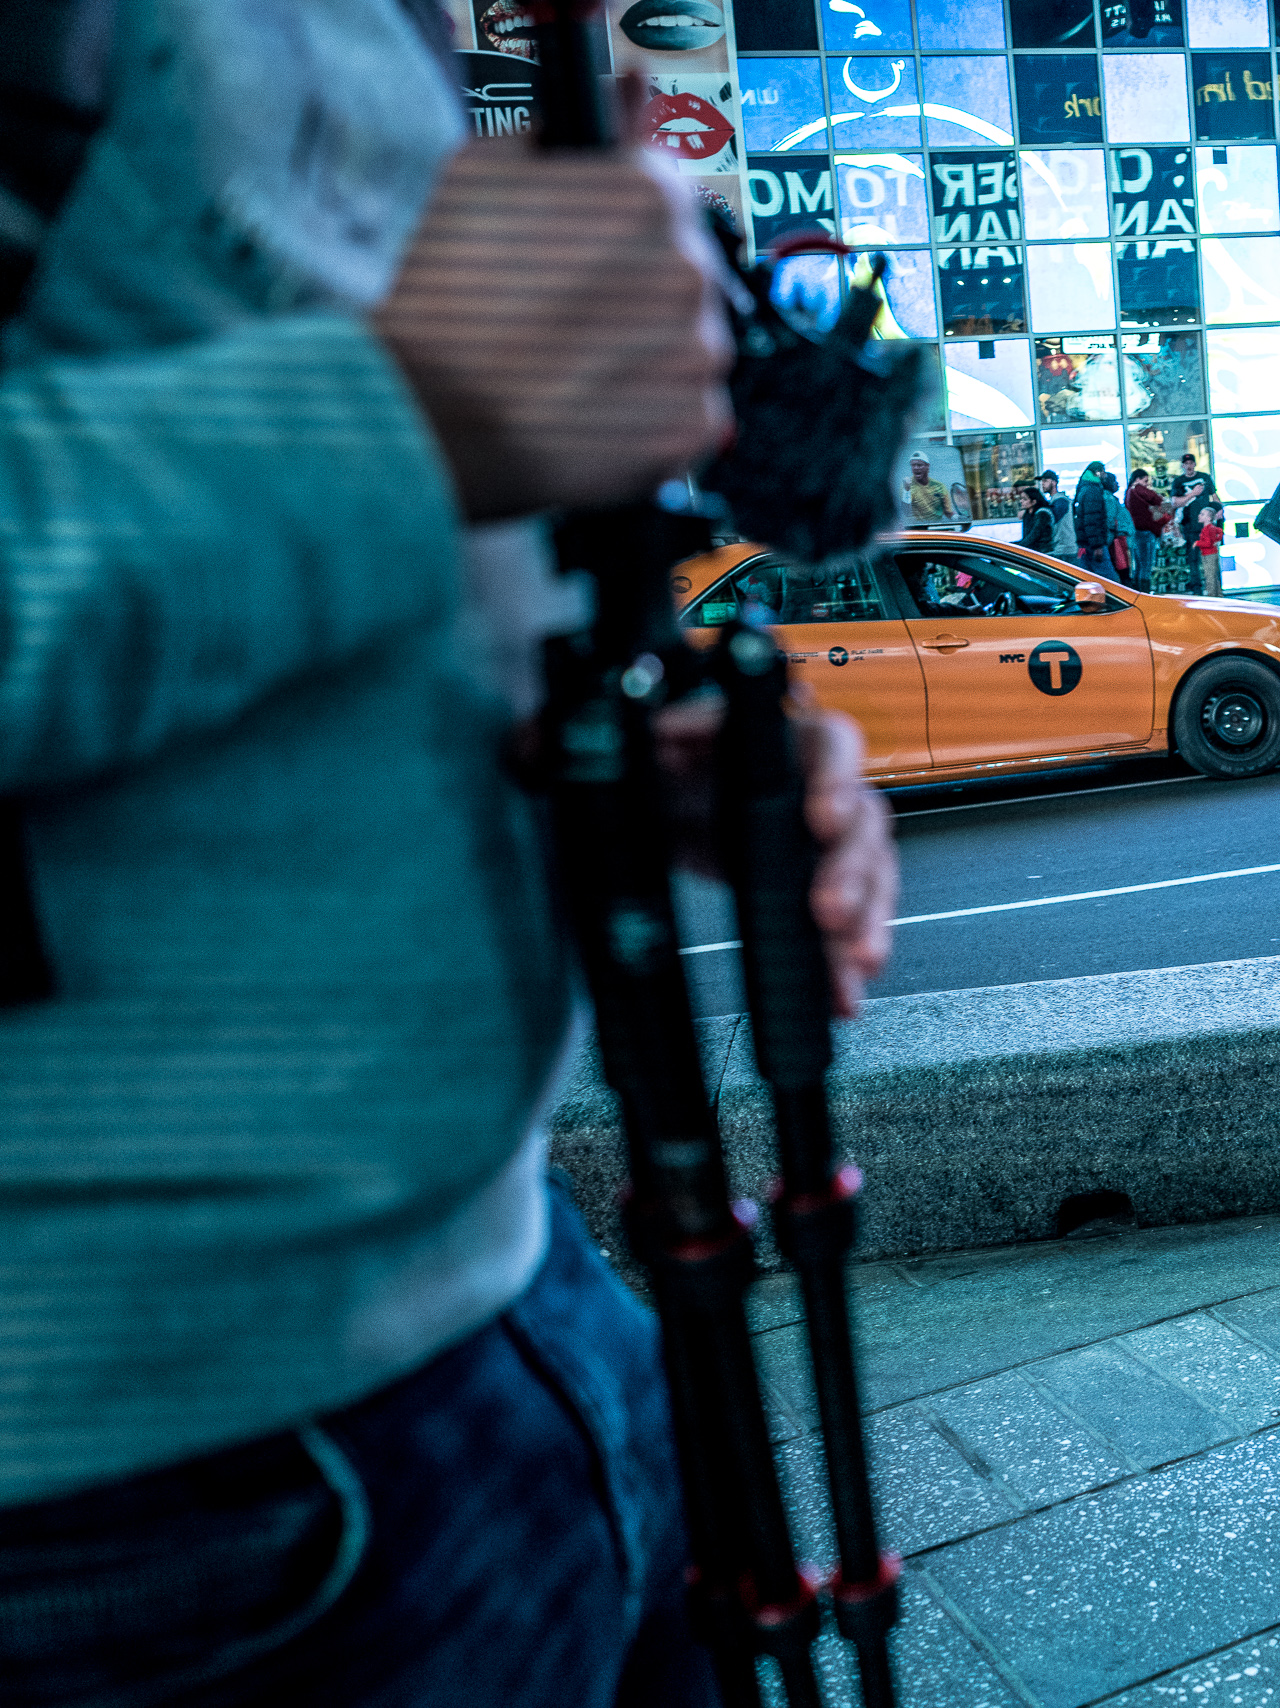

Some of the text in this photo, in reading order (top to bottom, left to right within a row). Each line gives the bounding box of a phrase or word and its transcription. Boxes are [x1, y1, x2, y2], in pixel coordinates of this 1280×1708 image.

[467, 106, 532, 137] TING
[999, 652, 1070, 689] NYC T
